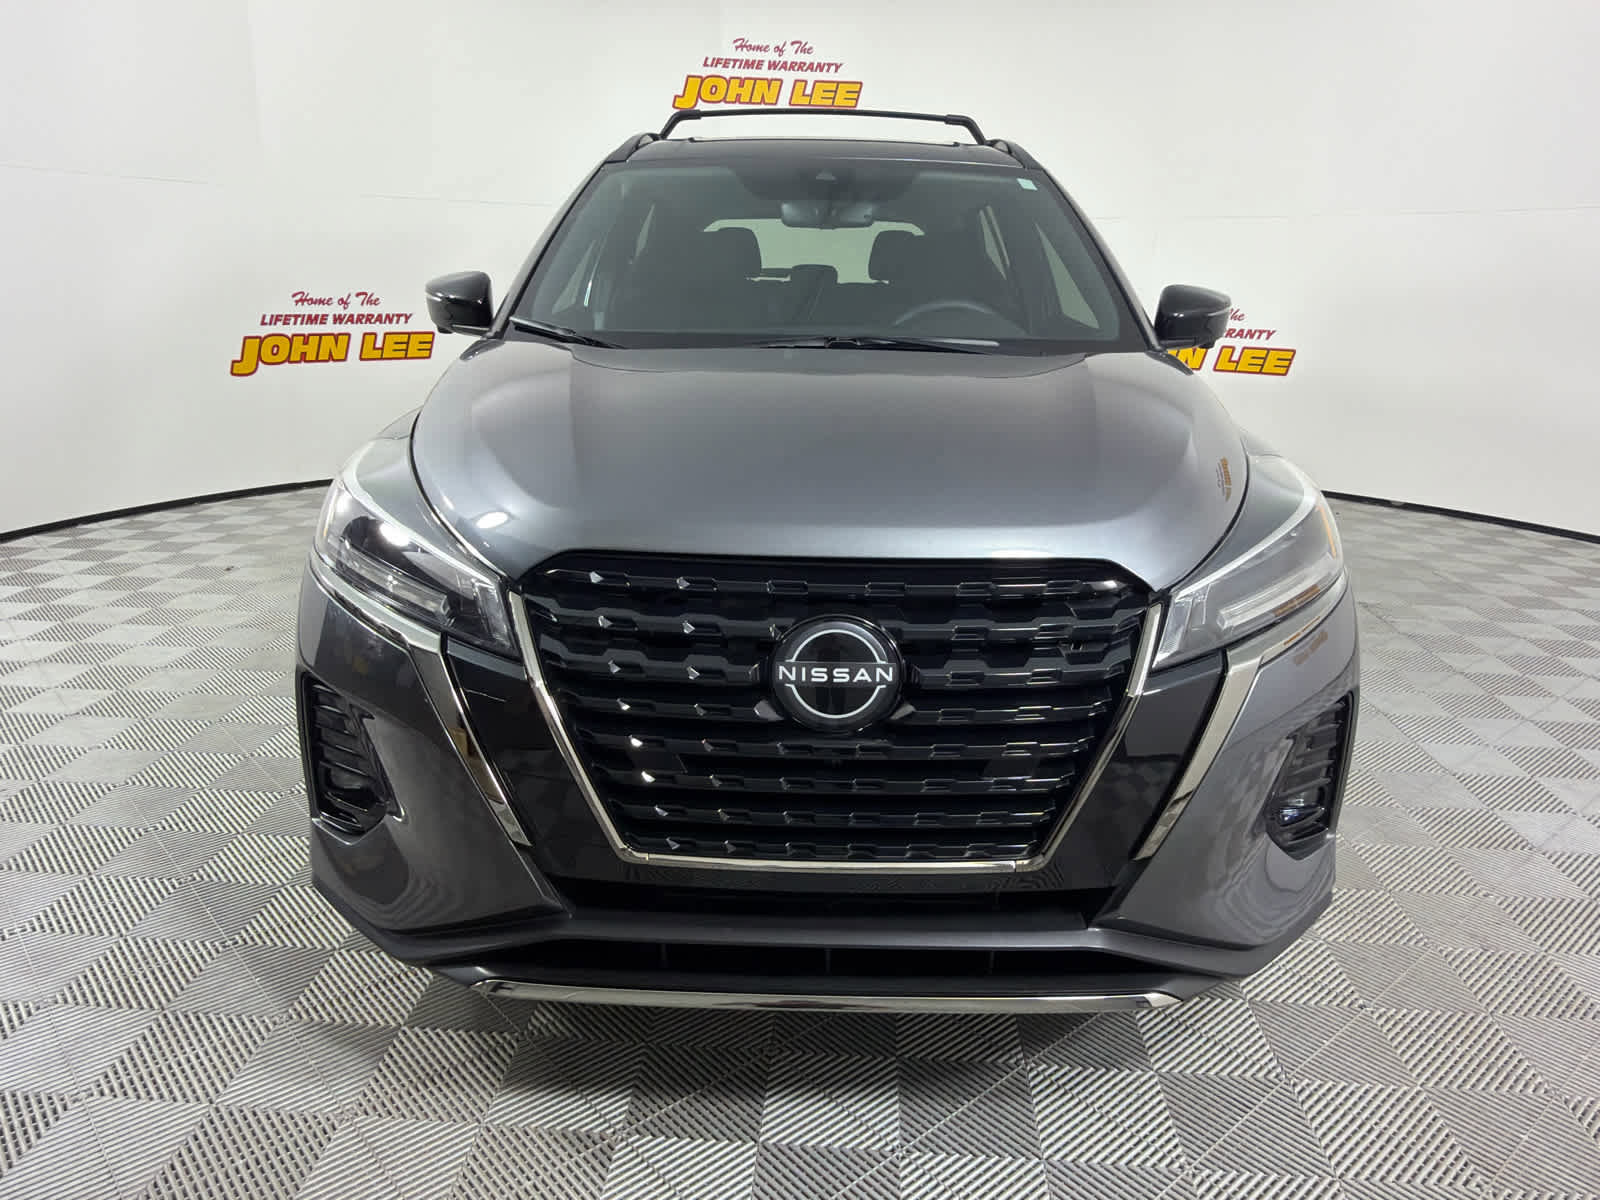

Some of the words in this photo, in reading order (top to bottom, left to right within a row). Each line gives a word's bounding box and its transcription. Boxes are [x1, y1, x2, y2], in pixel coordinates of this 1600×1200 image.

[733, 38, 770, 53] Home
[774, 41, 786, 57] of
[791, 40, 814, 54] The
[702, 57, 764, 70] LIFETIME
[768, 60, 843, 73] WARRANTY
[672, 74, 783, 109] JOHN
[789, 79, 863, 108] LEE
[291, 291, 333, 306] Home
[338, 294, 351, 310] of
[355, 291, 381, 306] The
[260, 314, 328, 326] LIFETIME
[332, 313, 413, 325] WARRANTY
[1228, 308, 1246, 321] he
[1224, 328, 1276, 340] RANTY
[230, 332, 351, 376] JOHN
[359, 331, 435, 361] LEE
[1212, 346, 1296, 376] LEE
[778, 665, 894, 683] NISSAN
